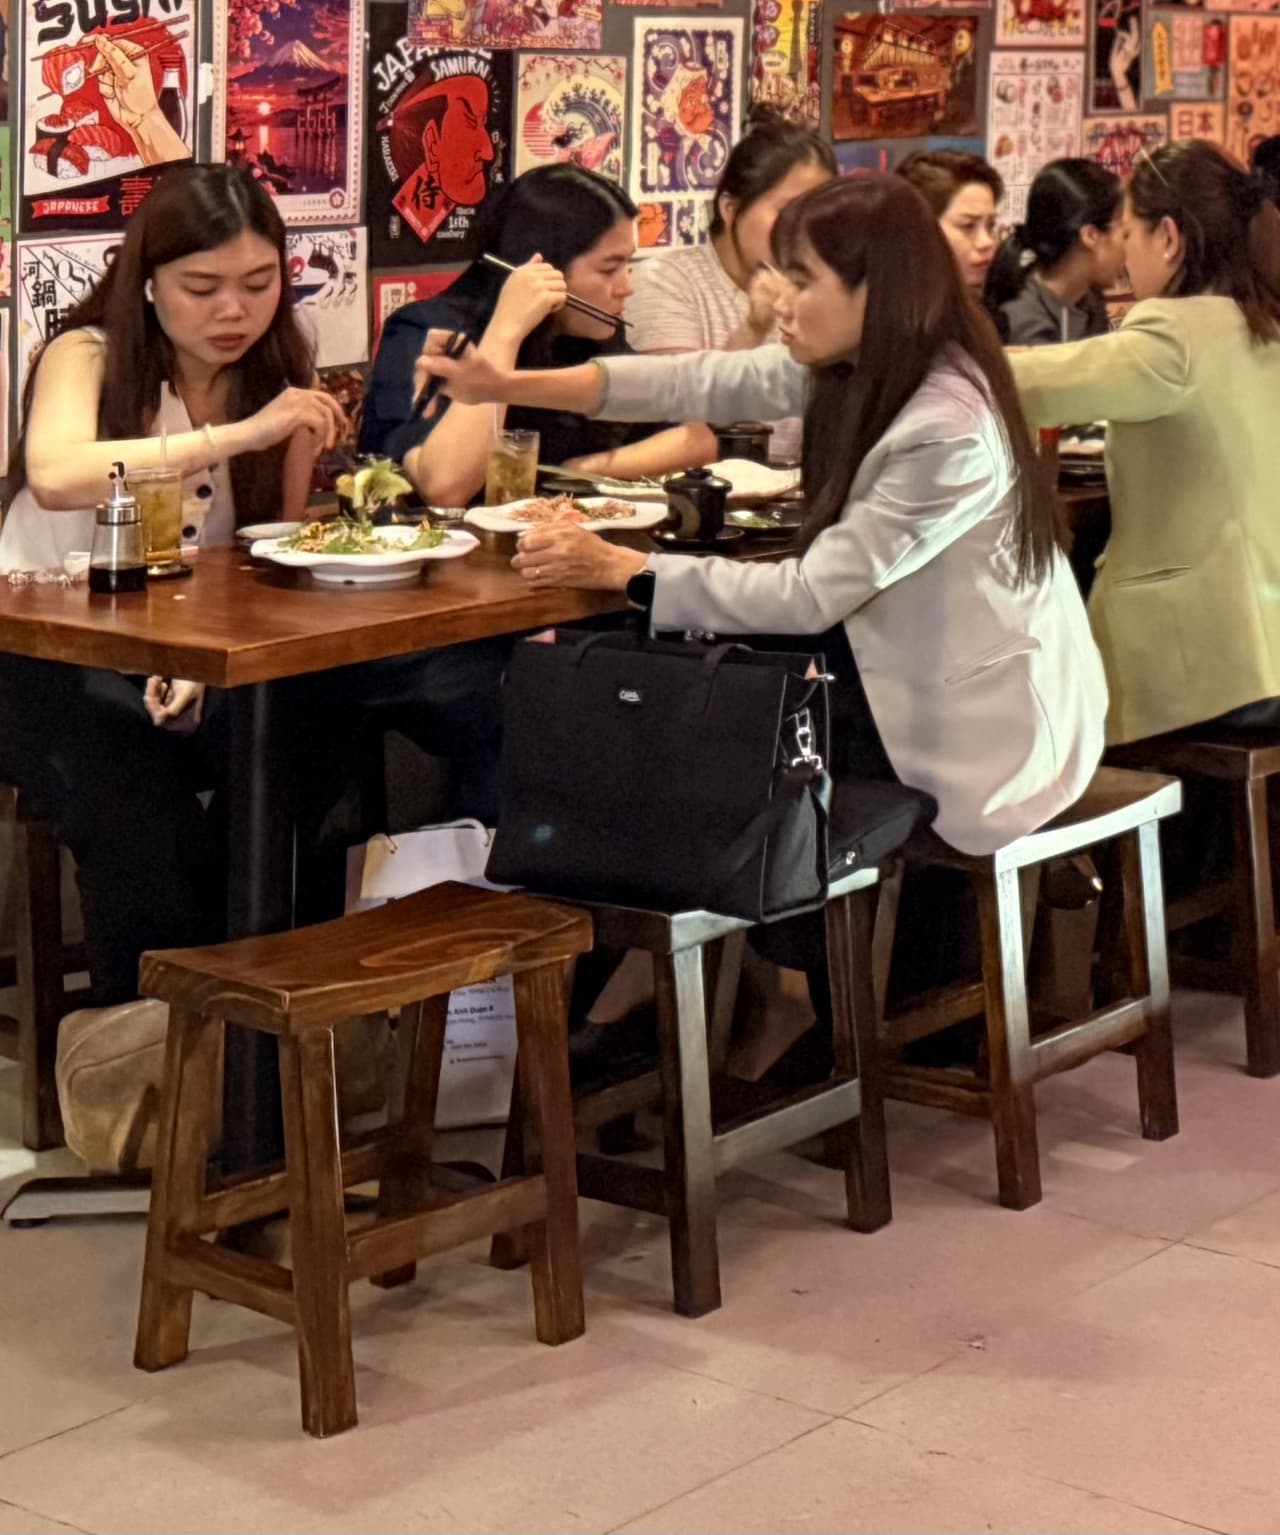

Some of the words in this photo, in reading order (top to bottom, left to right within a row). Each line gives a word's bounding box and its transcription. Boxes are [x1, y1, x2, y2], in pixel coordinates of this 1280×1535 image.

[430, 56, 490, 81] SAMURAI
[1178, 110, 1214, 137] 日本
[411, 175, 442, 211] 侍
[42, 200, 99, 215] JAPANESE
